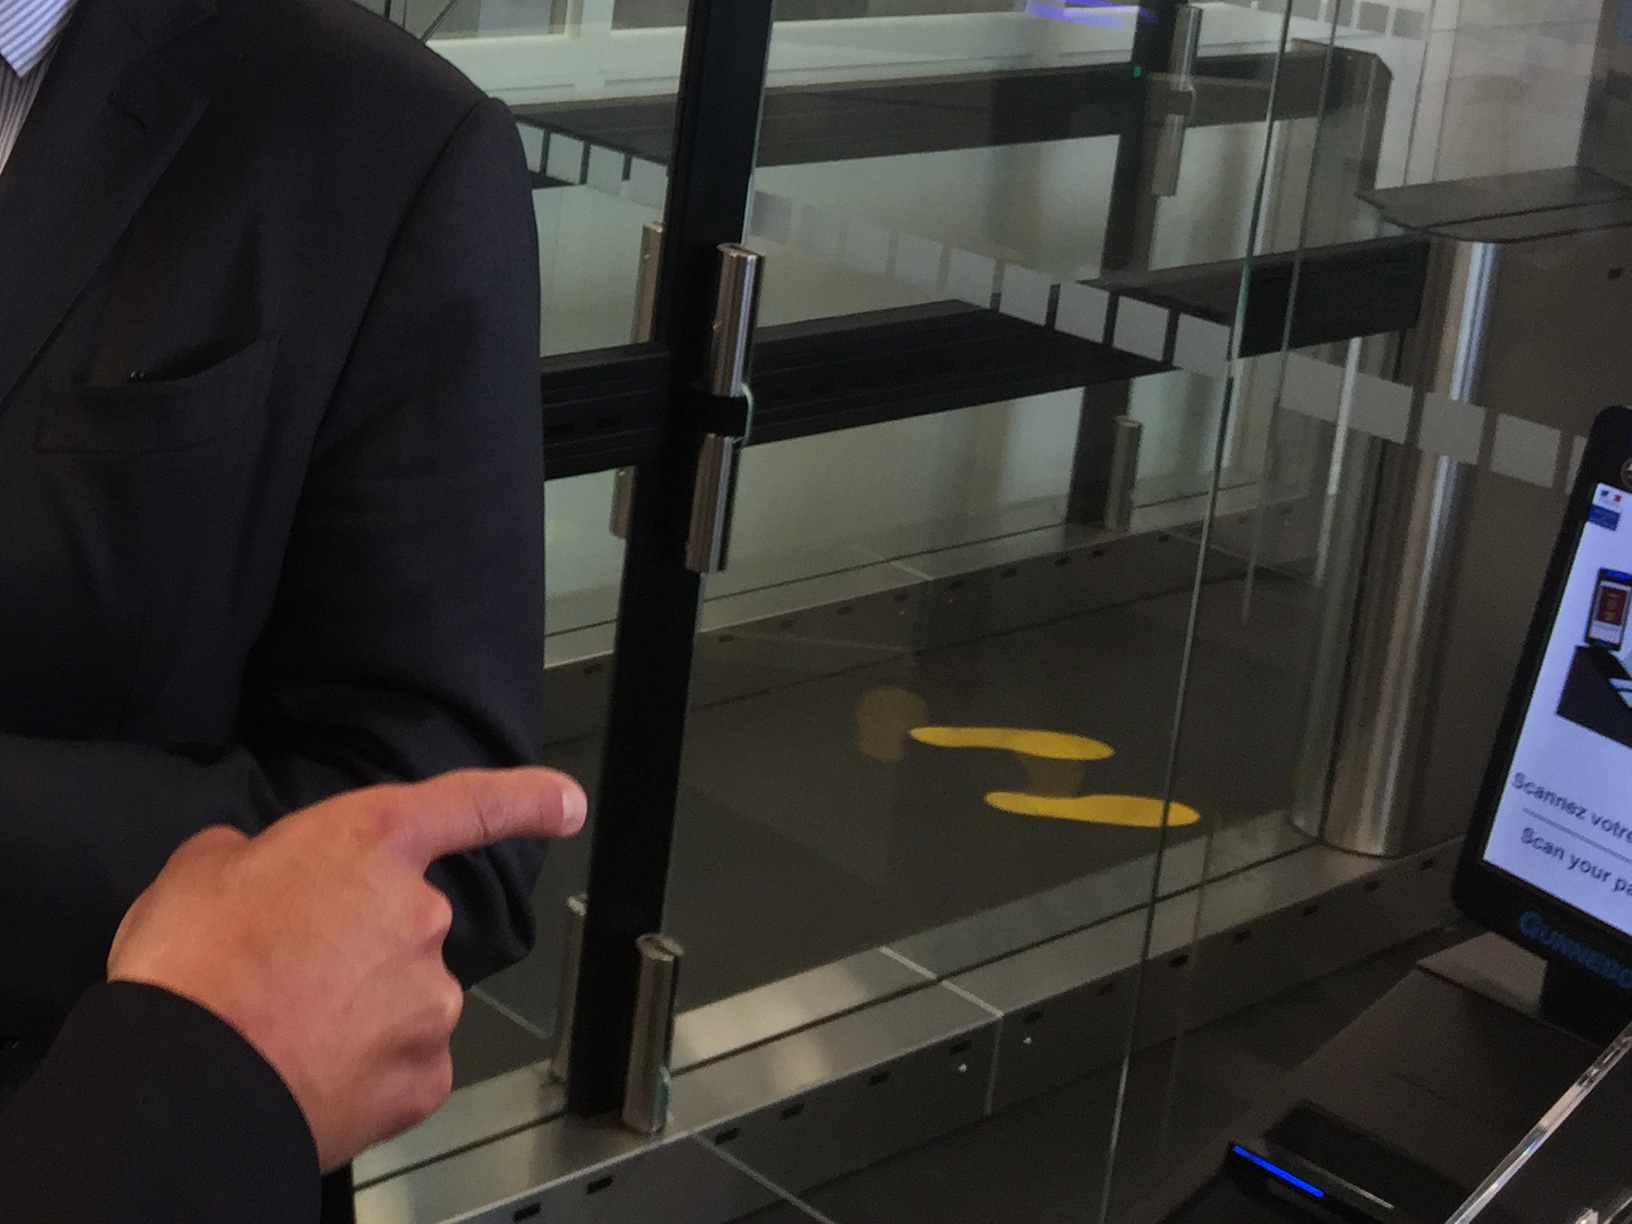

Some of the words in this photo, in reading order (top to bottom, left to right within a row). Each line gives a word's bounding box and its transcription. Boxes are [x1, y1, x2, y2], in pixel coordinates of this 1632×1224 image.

[1512, 772, 1588, 820] Scannez
[1521, 827, 1565, 860] Scan
[1568, 853, 1612, 883] your
[1613, 877, 1632, 896] pa
